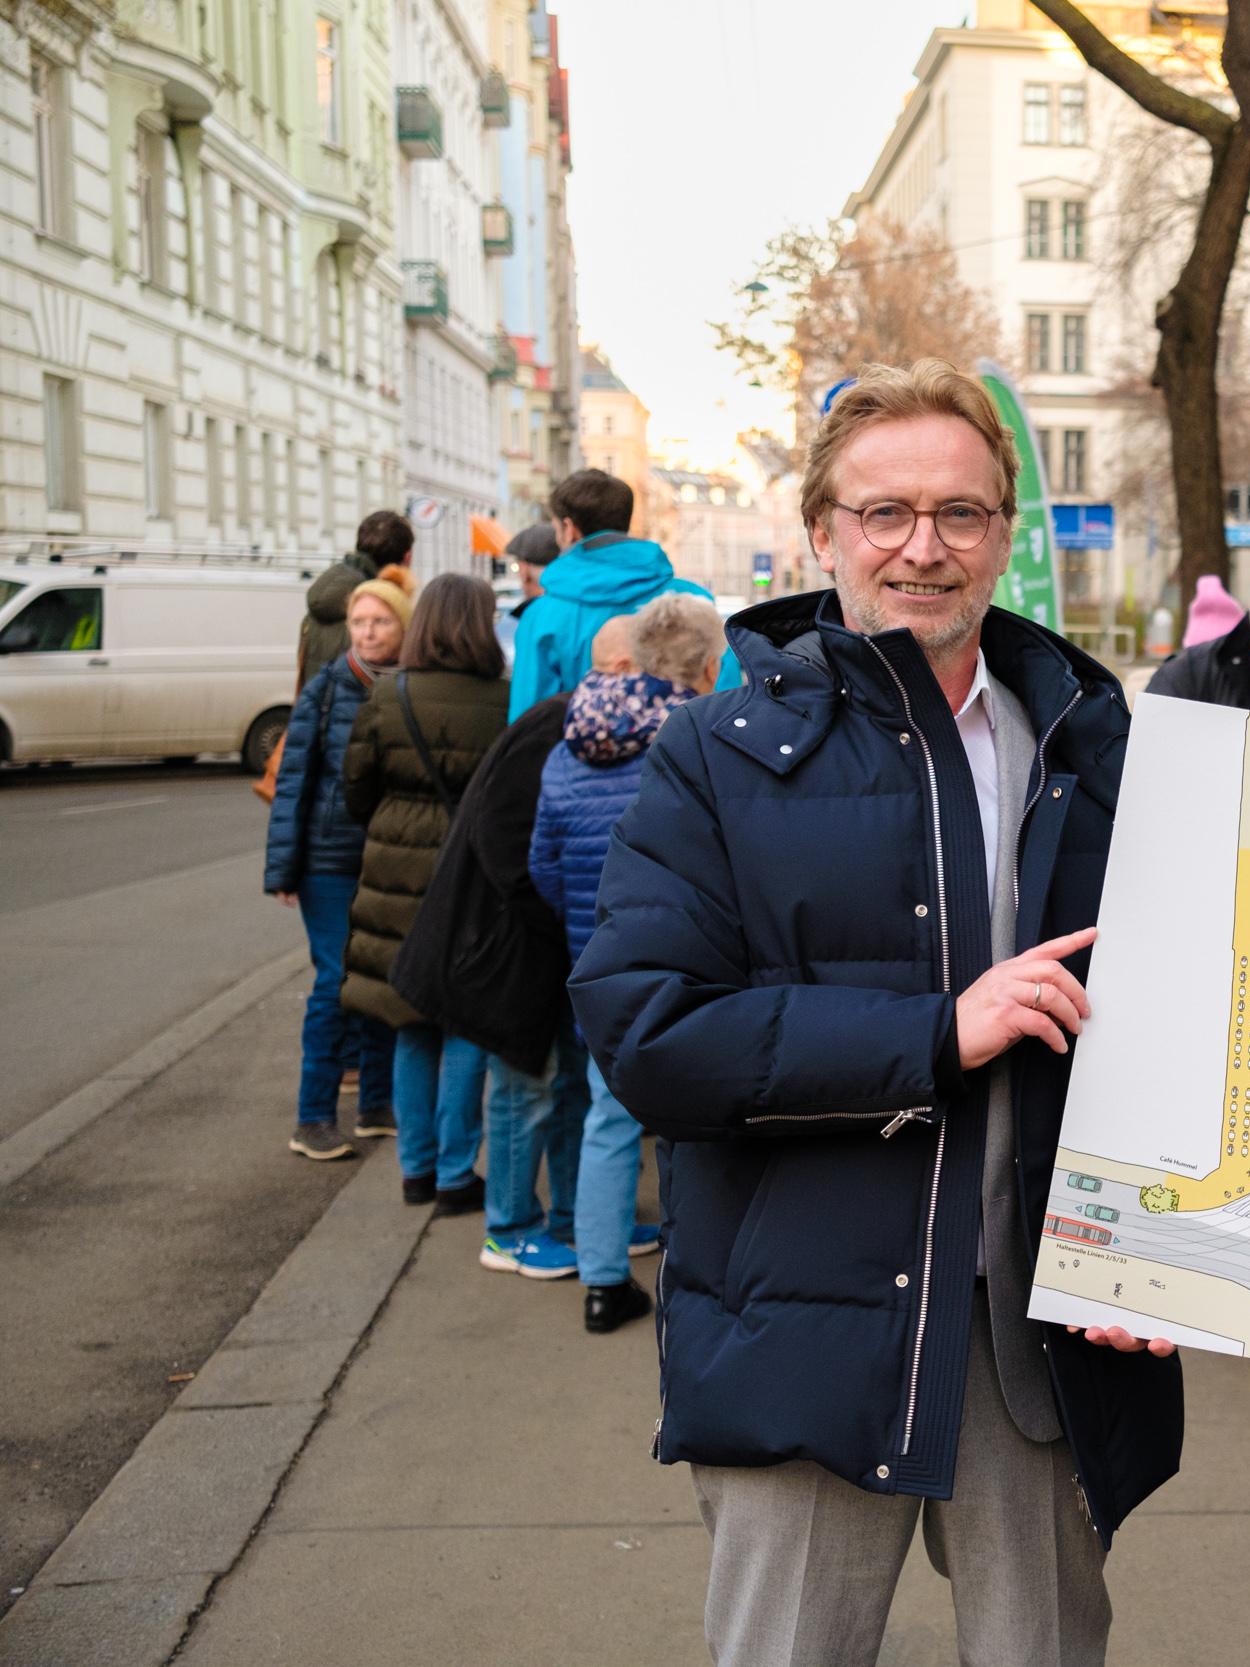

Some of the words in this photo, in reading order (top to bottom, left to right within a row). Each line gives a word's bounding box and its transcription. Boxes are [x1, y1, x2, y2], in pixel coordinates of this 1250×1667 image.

[1160, 1155, 1172, 1164] Café
[1174, 1159, 1198, 1170] Hummel
[1056, 1244, 1086, 1255] Haltestelle
[1087, 1250, 1105, 1260] Linien
[1105, 1254, 1128, 1265] 2/5/33
